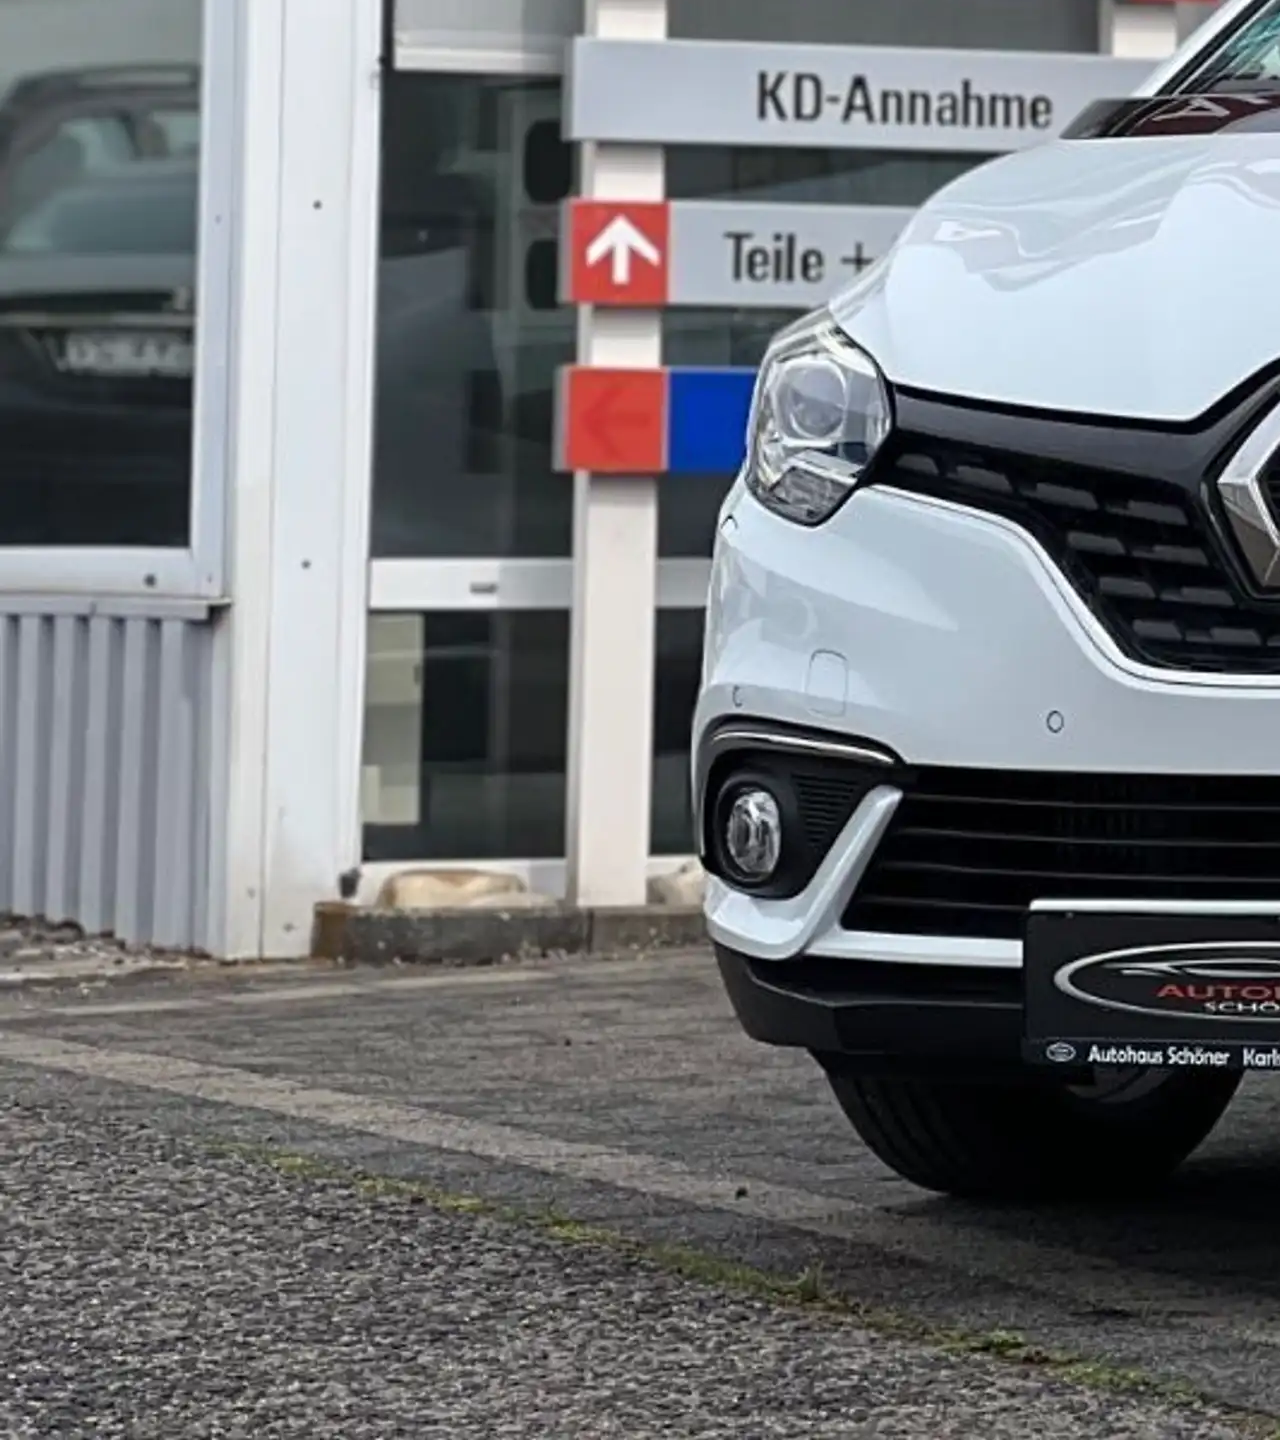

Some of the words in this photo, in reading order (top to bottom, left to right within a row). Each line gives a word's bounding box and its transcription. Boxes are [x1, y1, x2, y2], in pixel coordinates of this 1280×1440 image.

[757, 71, 1052, 129] KD-Annahme
[724, 231, 825, 283] Teile
[1087, 1045, 1164, 1065] Autohaus
[1167, 1046, 1231, 1067] Schöner
